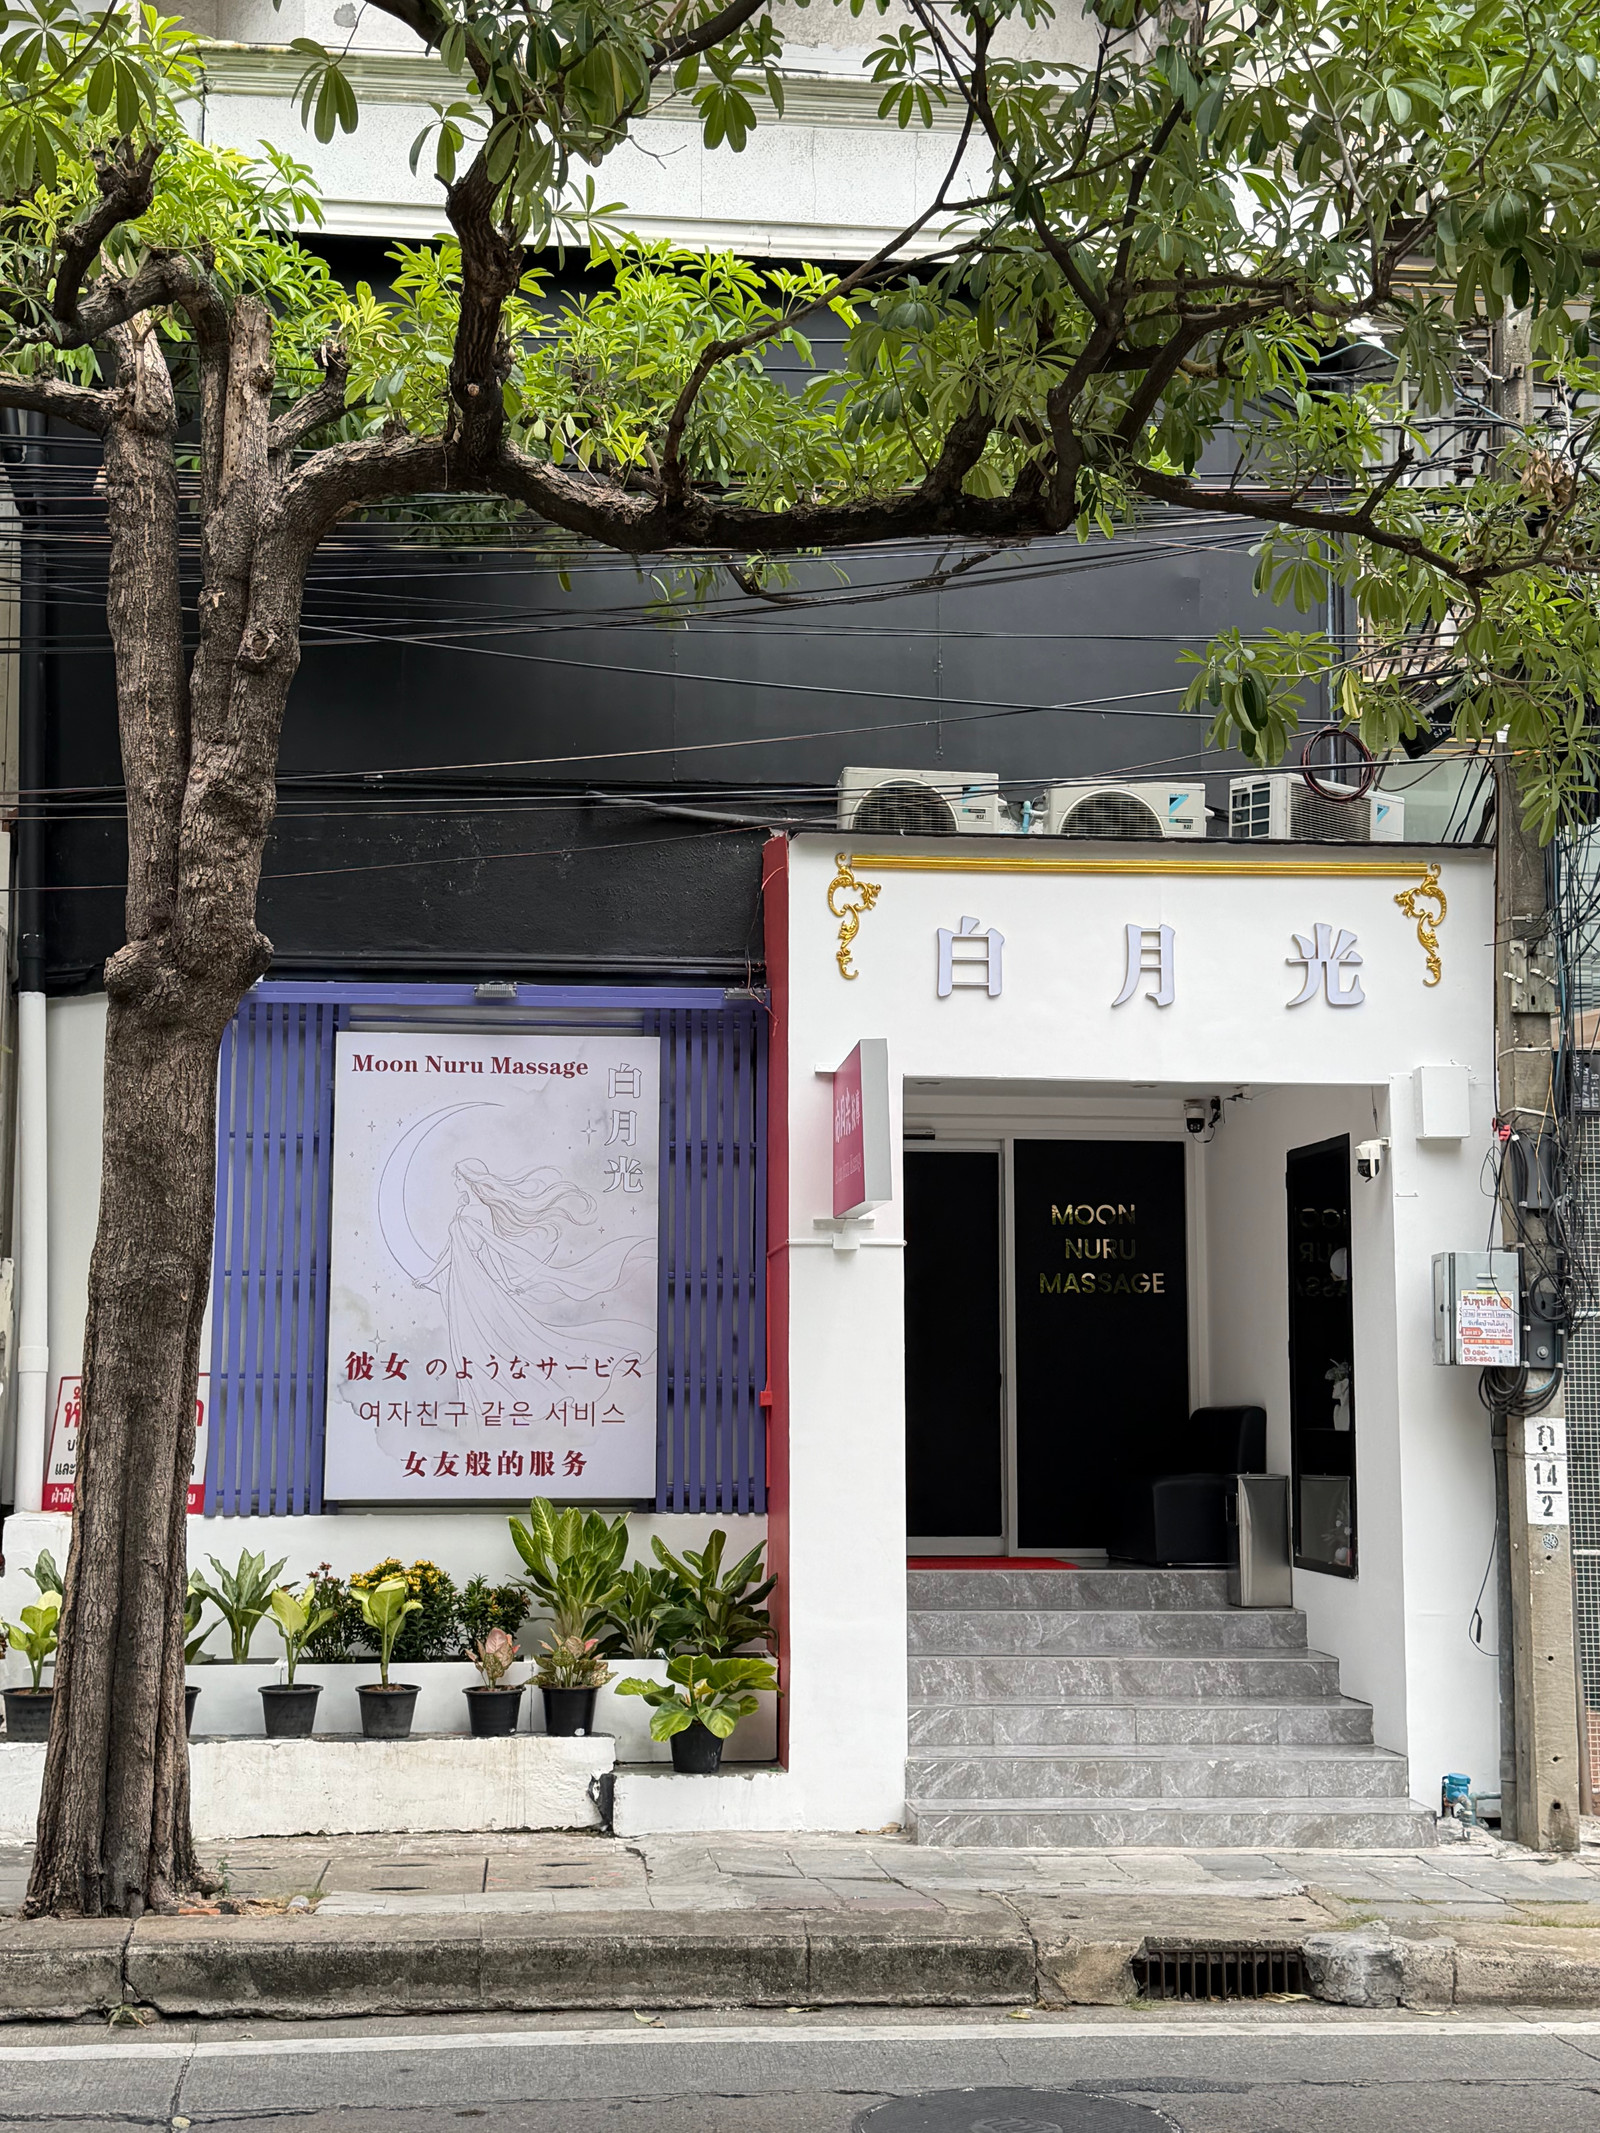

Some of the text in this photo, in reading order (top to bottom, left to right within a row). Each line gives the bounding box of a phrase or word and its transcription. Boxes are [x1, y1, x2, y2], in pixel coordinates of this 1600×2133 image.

[936, 916, 1366, 1008] 白月光
[352, 1054, 589, 1078] Moon Nuru Massage
[603, 1062, 644, 1194] 白月光
[1051, 1204, 1136, 1226] MOON
[1065, 1238, 1136, 1260] NURU
[1039, 1272, 1165, 1294] MASSAGE
[360, 1400, 626, 1427] 여자친구 같은 서비스
[401, 1450, 588, 1477] 女友般的服务
[1534, 1463, 1557, 1486] 14
[1541, 1495, 1554, 1517] 2
